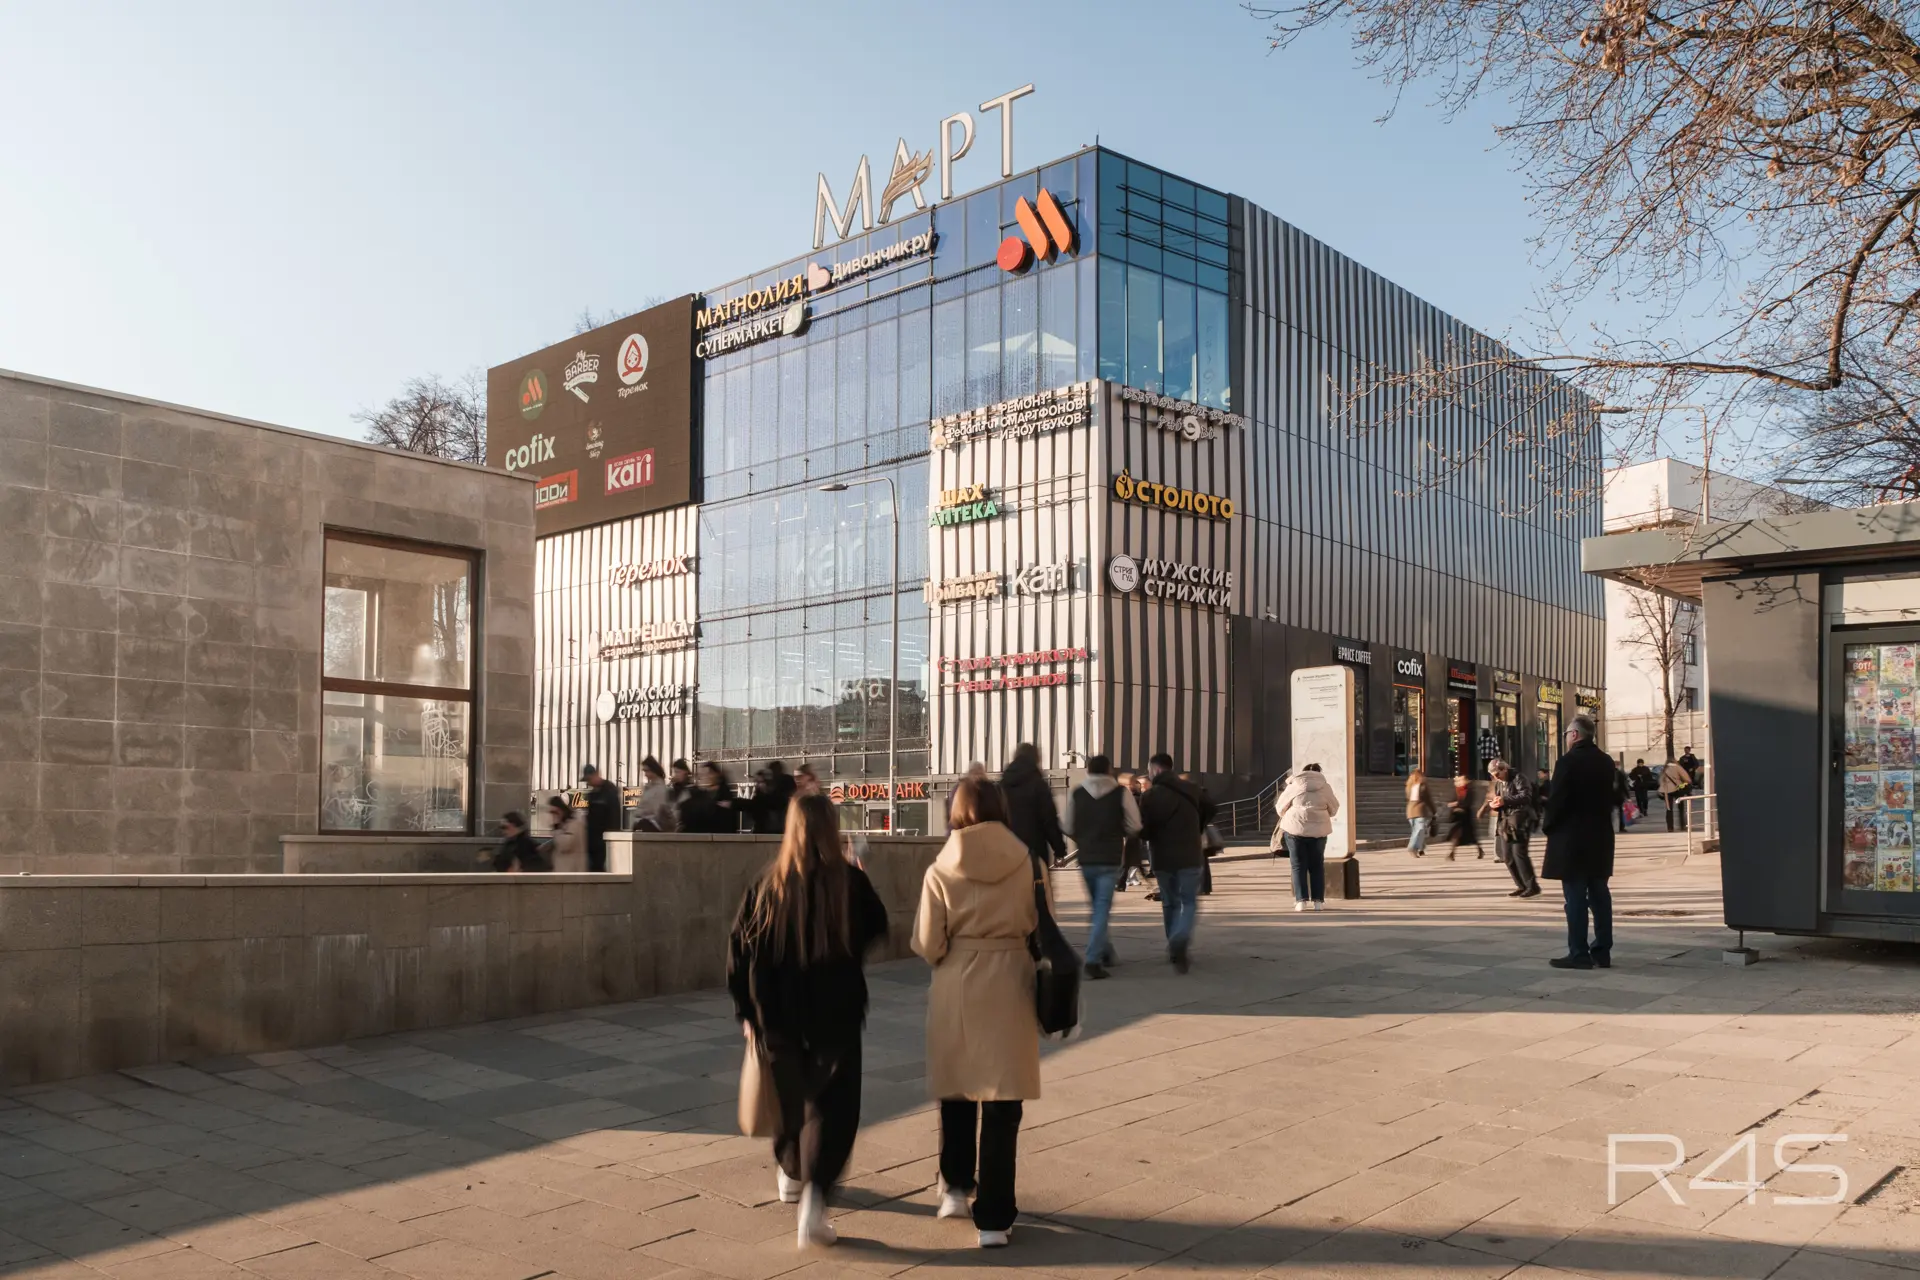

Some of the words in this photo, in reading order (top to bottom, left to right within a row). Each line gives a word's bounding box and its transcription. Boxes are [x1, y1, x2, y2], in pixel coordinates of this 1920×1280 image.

[812, 83, 1036, 250] МАРТ
[831, 229, 933, 283] Диванчик.ру
[696, 273, 803, 330] МАГНОЛИЯ
[696, 314, 784, 358] СУПЕРМАРКЕТ
[565, 359, 600, 381] BARBER
[617, 381, 648, 398] Теремок
[1001, 399, 1084, 428] СМАРТФОНОВ
[1013, 412, 1082, 438] НОУТБУКОВ
[505, 433, 556, 472] cofix
[607, 454, 652, 491] kari
[939, 483, 985, 506] ШАХ
[1136, 480, 1235, 520] СТОЛОТО
[929, 500, 998, 528] АПТЕКА
[609, 553, 688, 589] Теремок
[1142, 557, 1233, 589] МУЖСКИЕ
[1144, 578, 1232, 608] СТРИЖКИ
[600, 619, 689, 647] МАТРЁШКА
[1341, 646, 1356, 663] PRICE
[1355, 649, 1372, 665] COFFEE
[1397, 658, 1423, 677] cofix
[617, 683, 683, 704] МУЖСКИЕ
[618, 702, 681, 719] СТРИЖКИ
